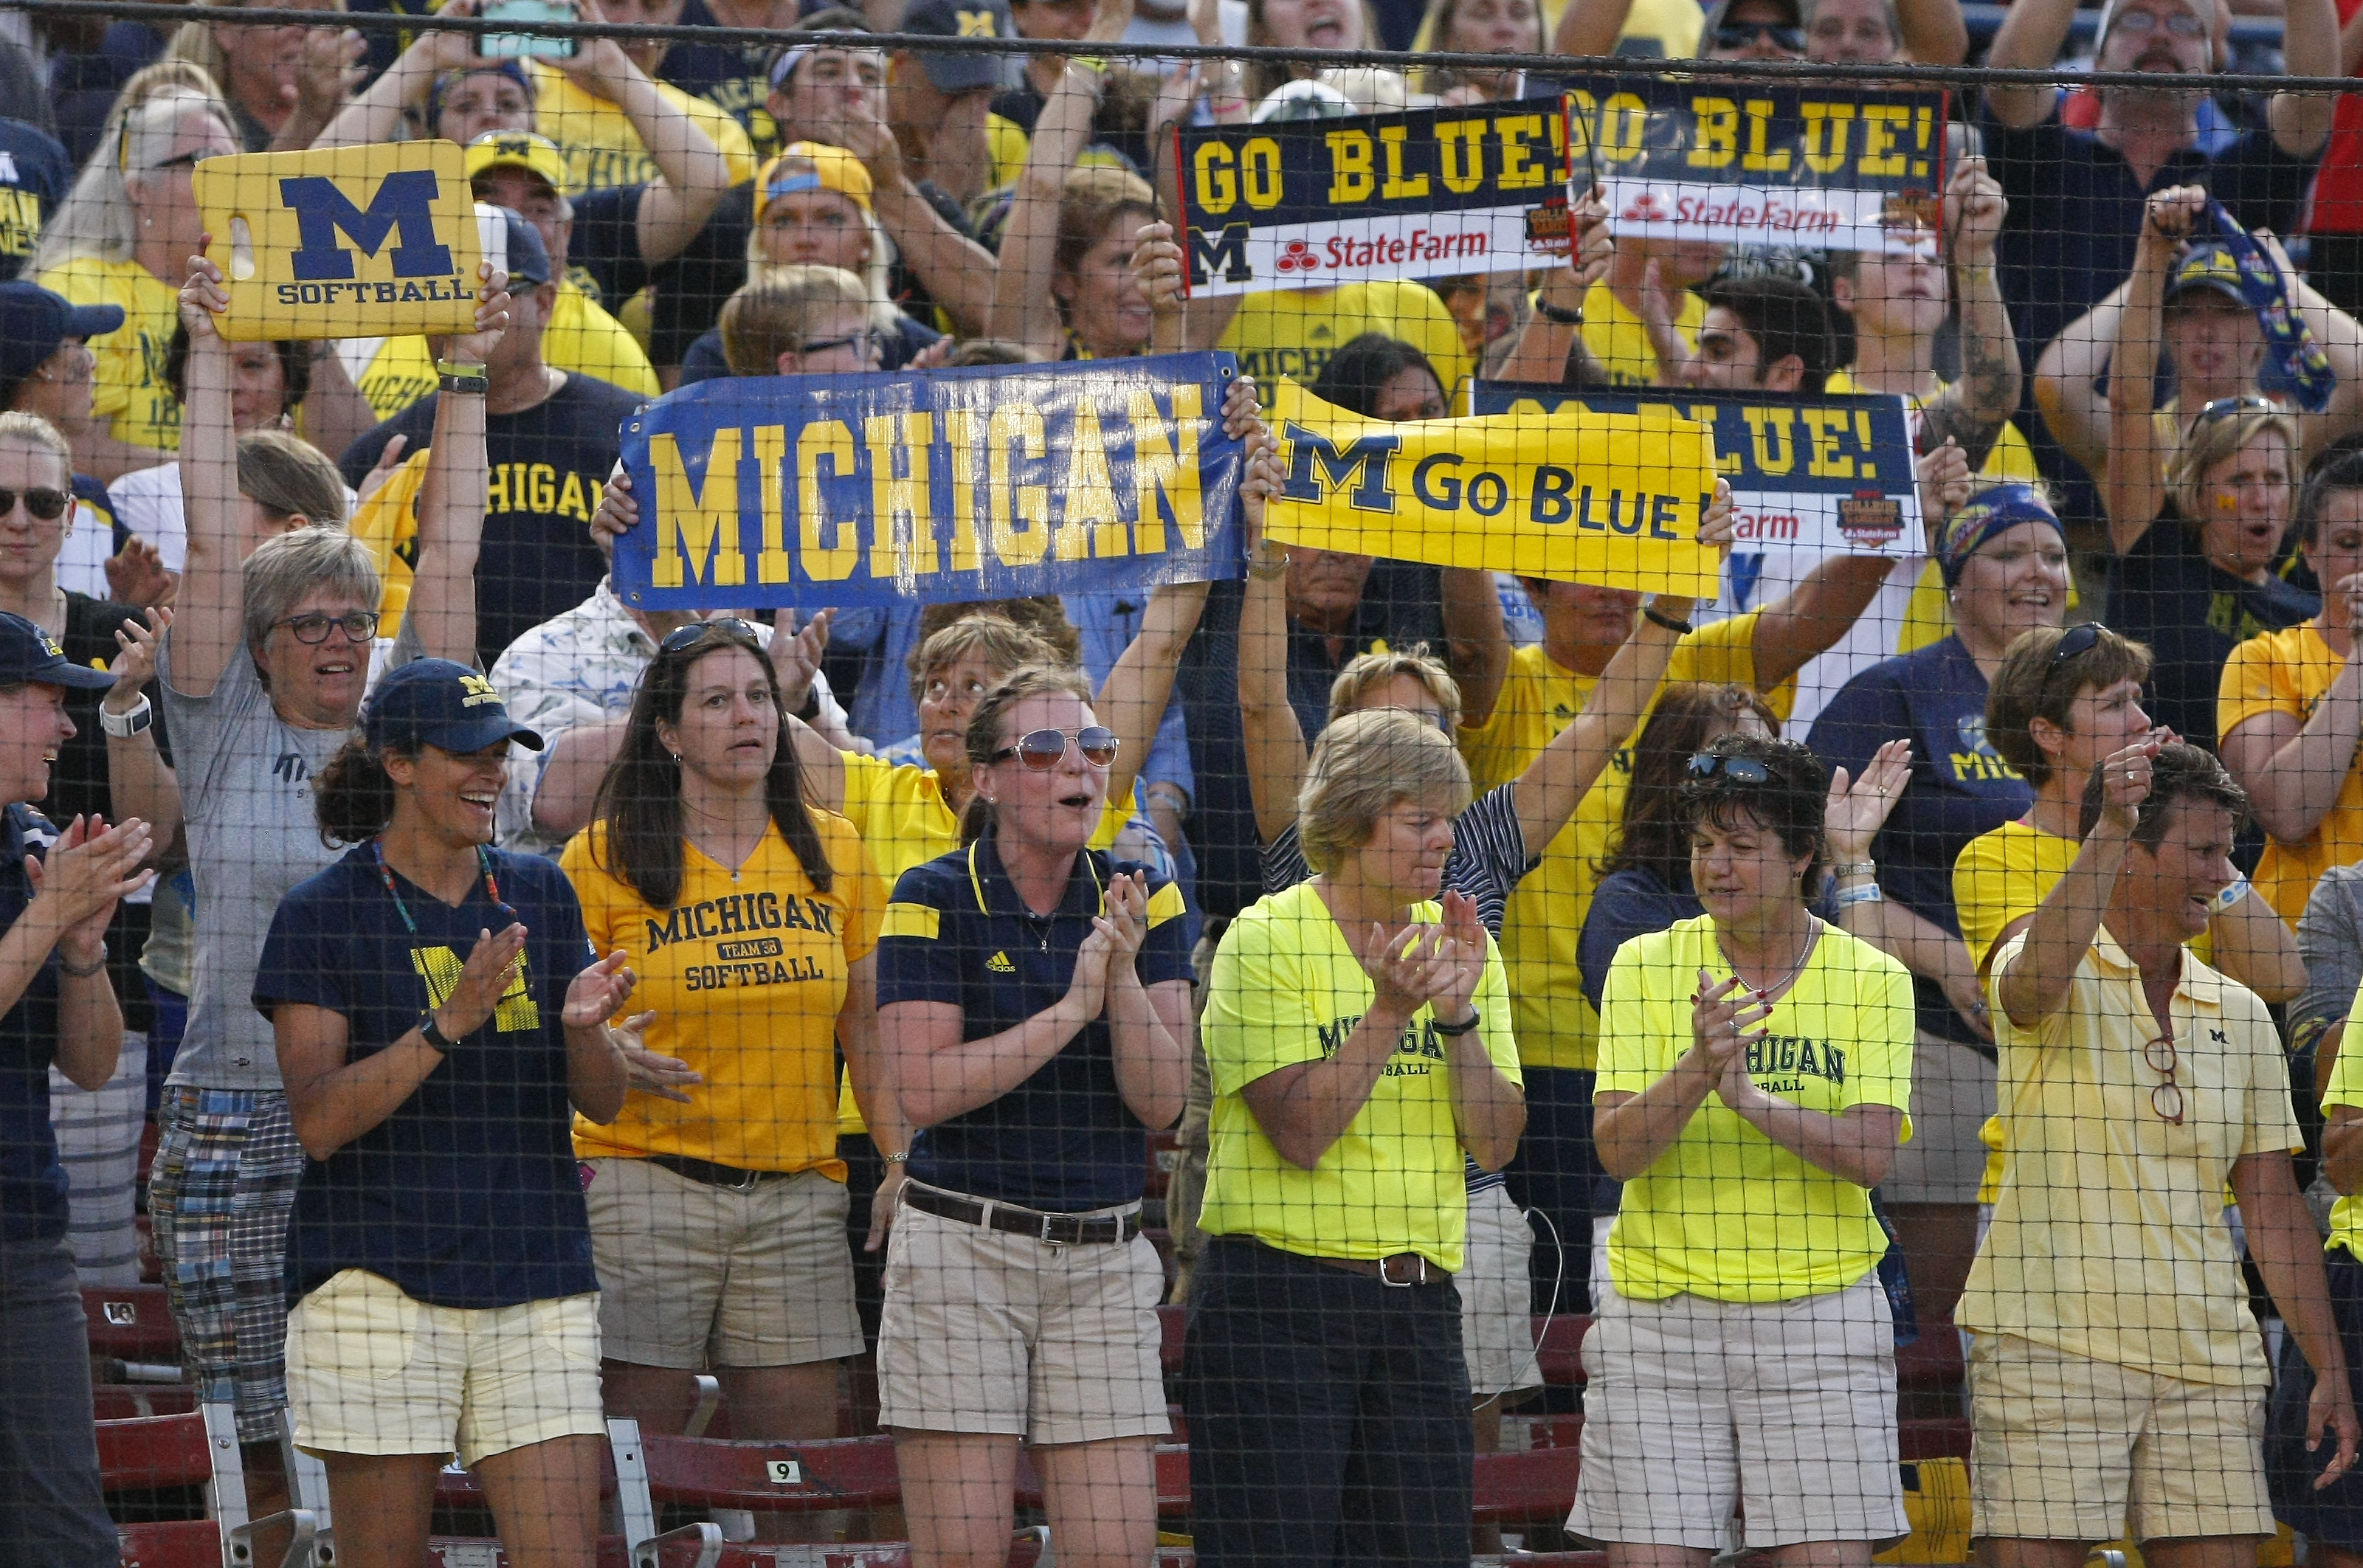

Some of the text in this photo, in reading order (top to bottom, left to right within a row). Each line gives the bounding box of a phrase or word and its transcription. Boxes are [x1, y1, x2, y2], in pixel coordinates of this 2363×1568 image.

[1193, 113, 1570, 215] GO BLUE!
[1566, 89, 1933, 178] GO BLUE!
[278, 169, 455, 280] M
[1186, 222, 1252, 286] M
[277, 278, 475, 305] SOFTBALL
[649, 383, 1207, 588] MICHIGAN
[1281, 418, 1403, 515] M
[646, 891, 835, 955] MICHIGAN
[722, 942, 760, 958] TEAM
[685, 956, 824, 991] SOFTBALL
[776, 1463, 790, 1480] 9
